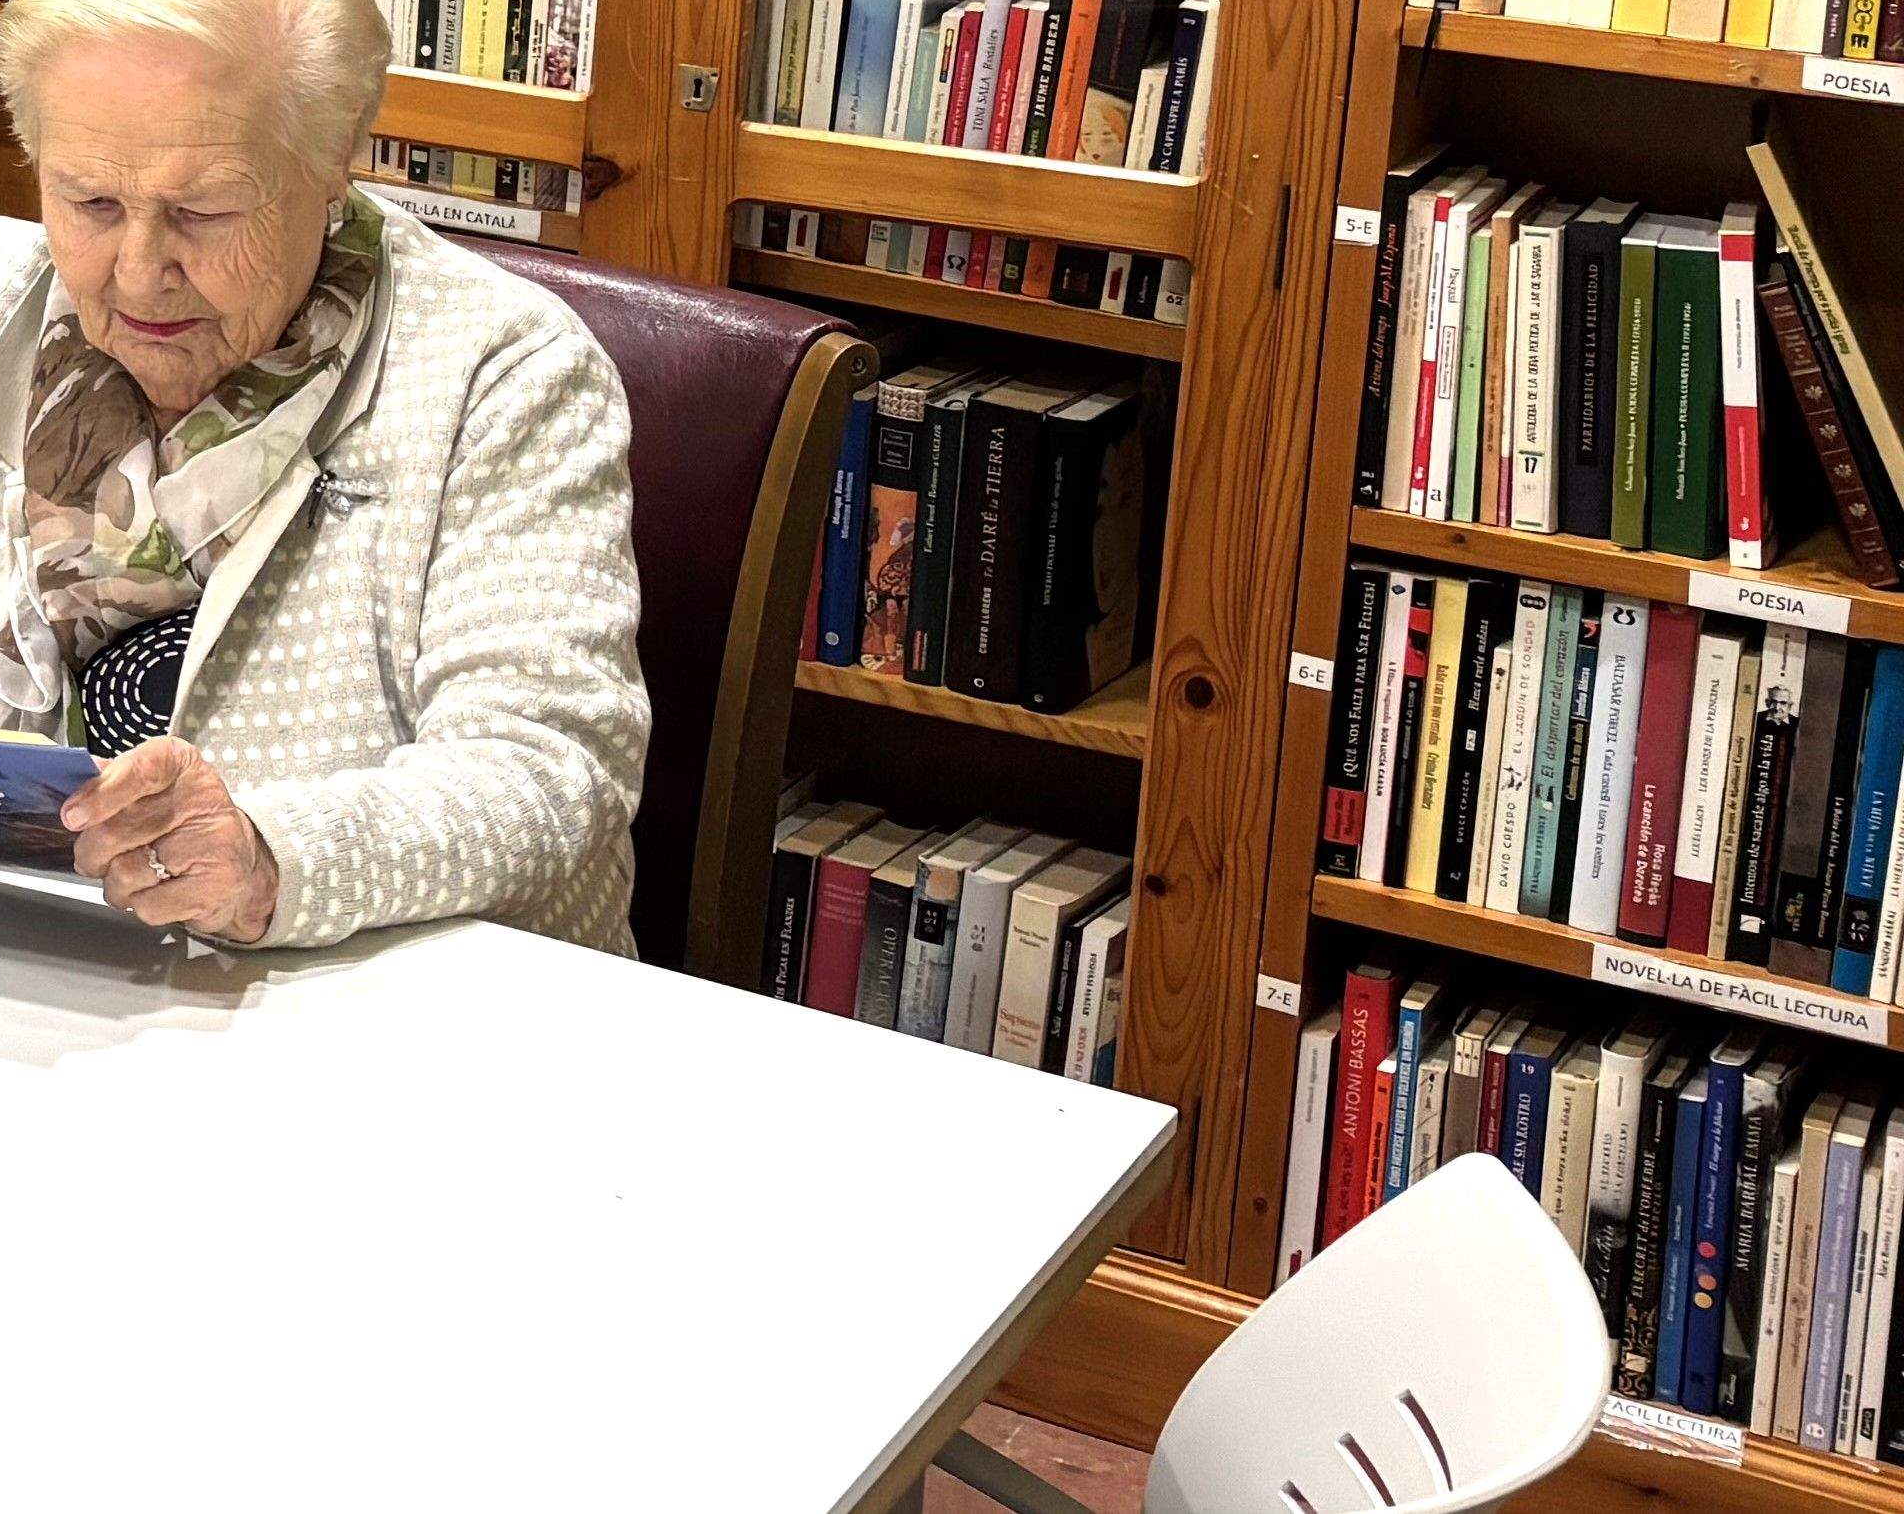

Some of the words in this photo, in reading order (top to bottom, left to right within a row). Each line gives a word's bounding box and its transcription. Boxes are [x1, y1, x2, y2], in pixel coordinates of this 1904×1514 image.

[445, 19, 455, 34] DE
[443, 35, 455, 68] TEMPS
[1822, 71, 1890, 97] POESIA
[975, 85, 987, 112] SALA
[1033, 80, 1050, 118] JAUME
[973, 111, 983, 132] TONI
[1162, 97, 1179, 156] CAPVESPRE
[443, 205, 462, 220] EN
[465, 208, 516, 229] CATALÀ
[1346, 219, 1373, 235] 5-E
[1586, 264, 1602, 328] FELICIDAD
[1585, 331, 1600, 349] LA
[1584, 351, 1599, 368] DE
[1580, 370, 1600, 454] PARTIDARIOS
[986, 425, 1007, 497] TIERRA
[1524, 456, 1538, 474] 17
[1429, 489, 1442, 503] a
[980, 510, 999, 564] DARÉ
[1739, 587, 1804, 614] POESIA
[1298, 666, 1325, 683] 6-E
[1266, 987, 1293, 1005] 7-E
[1605, 957, 1693, 990] NOVEL·LA
[1700, 978, 1724, 996] DE
[1729, 983, 1780, 1009] FÀCIL
[1784, 997, 1869, 1030] LECTURA
[1349, 1007, 1369, 1077] BASSAS
[1521, 1063, 1535, 1076] 19
[1345, 1080, 1362, 1139] ANTONI
[1657, 1413, 1737, 1444] LECTURA
